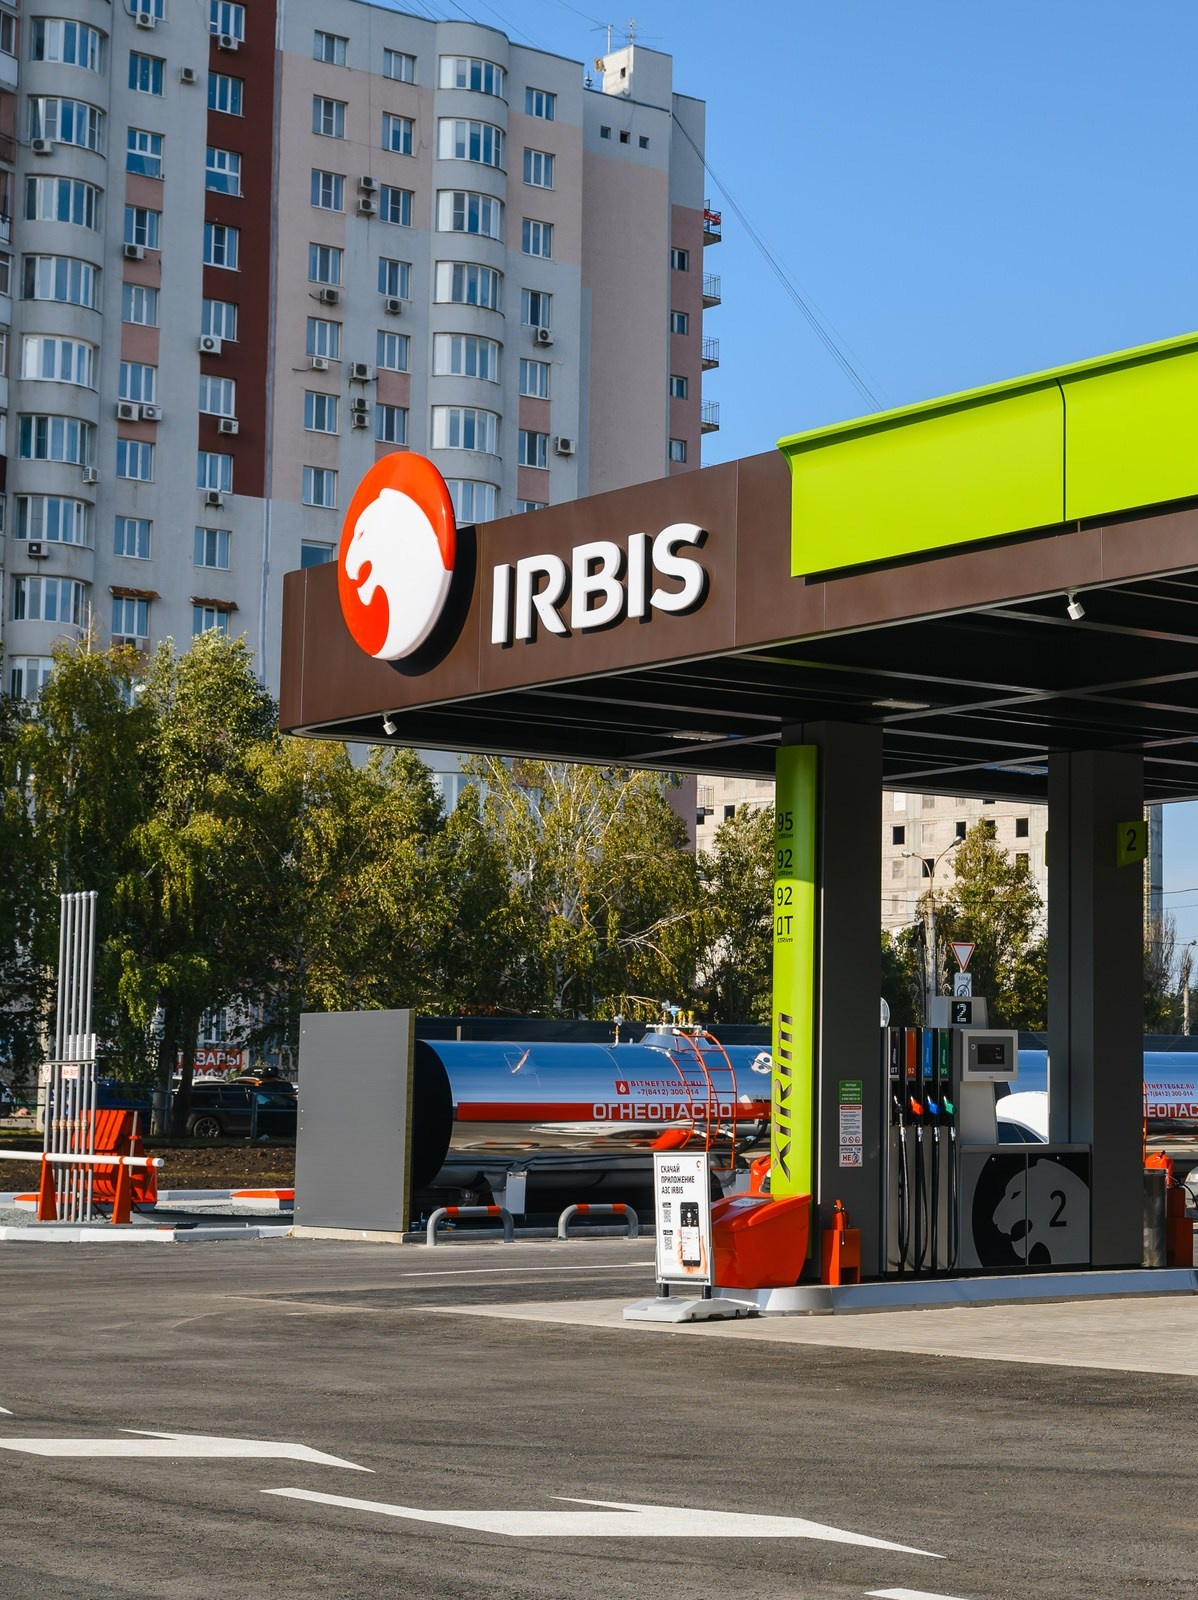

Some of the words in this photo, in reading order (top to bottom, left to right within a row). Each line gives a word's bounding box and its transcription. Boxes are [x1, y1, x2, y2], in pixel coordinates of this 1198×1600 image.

[491, 523, 704, 645] IRBIS
[777, 812, 794, 832] 95
[1126, 829, 1137, 851] 2
[777, 849, 793, 869] 92
[777, 886, 793, 906] 92
[777, 916, 793, 936] ДТ
[957, 1003, 966, 1022] 2
[177, 1052, 240, 1066] ТВАРЫ
[637, 1088, 669, 1096] +7(8412)
[771, 1012, 793, 1183] XTRim
[593, 1103, 733, 1119] ОГНЕОПАСНО
[661, 1164, 680, 1173] СКАЧАЙ
[661, 1175, 695, 1184] ПРИЛОЖЕНИЕ
[661, 1186, 671, 1194] АЗС
[671, 1186, 684, 1194] IRBIS
[1049, 1189, 1067, 1228] 2
